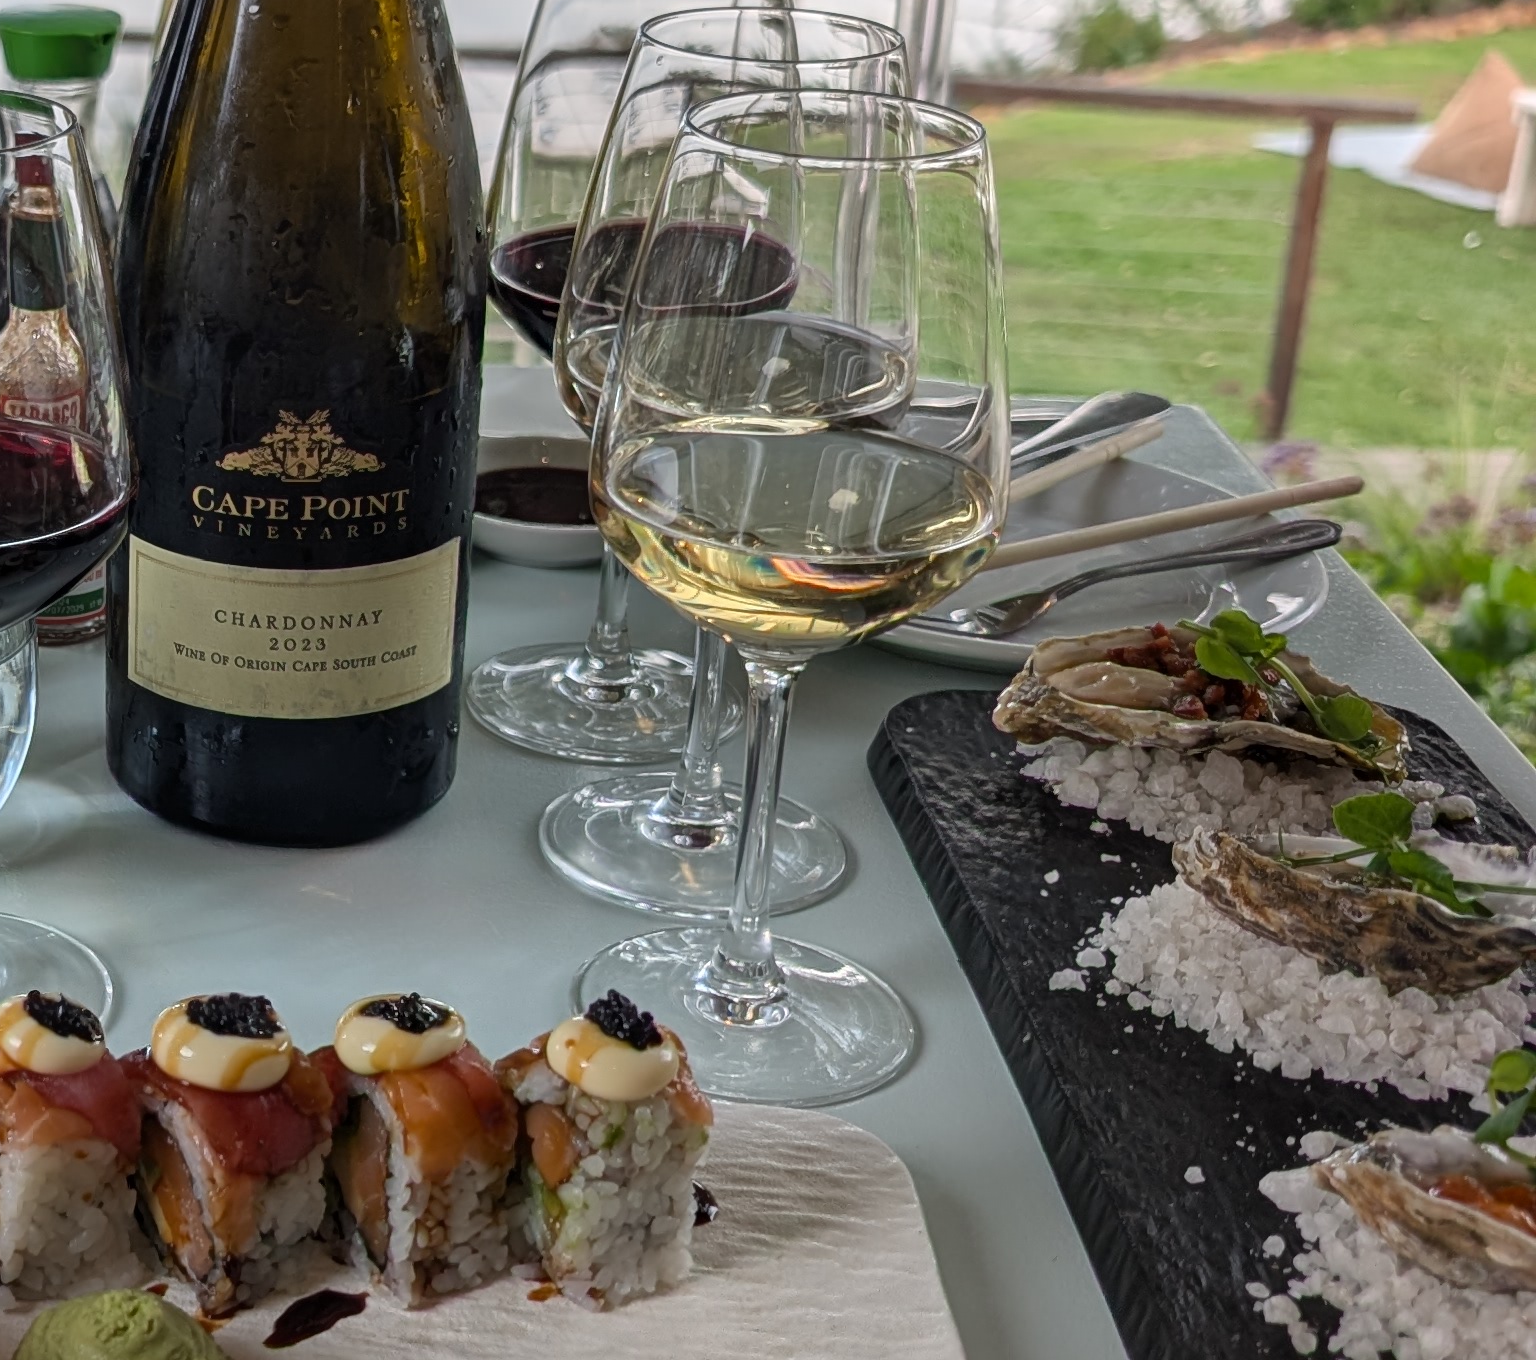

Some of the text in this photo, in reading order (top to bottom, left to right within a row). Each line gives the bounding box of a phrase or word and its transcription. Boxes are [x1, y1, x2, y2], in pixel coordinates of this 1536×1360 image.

[192, 485, 410, 521] CAPE POINT
[192, 514, 408, 540] VINEYARDS
[214, 609, 383, 631] CHARDONNAY
[173, 641, 418, 672] WINE OF ORIGIN CAPE SOUTH COAST
[268, 637, 327, 652] 2023
